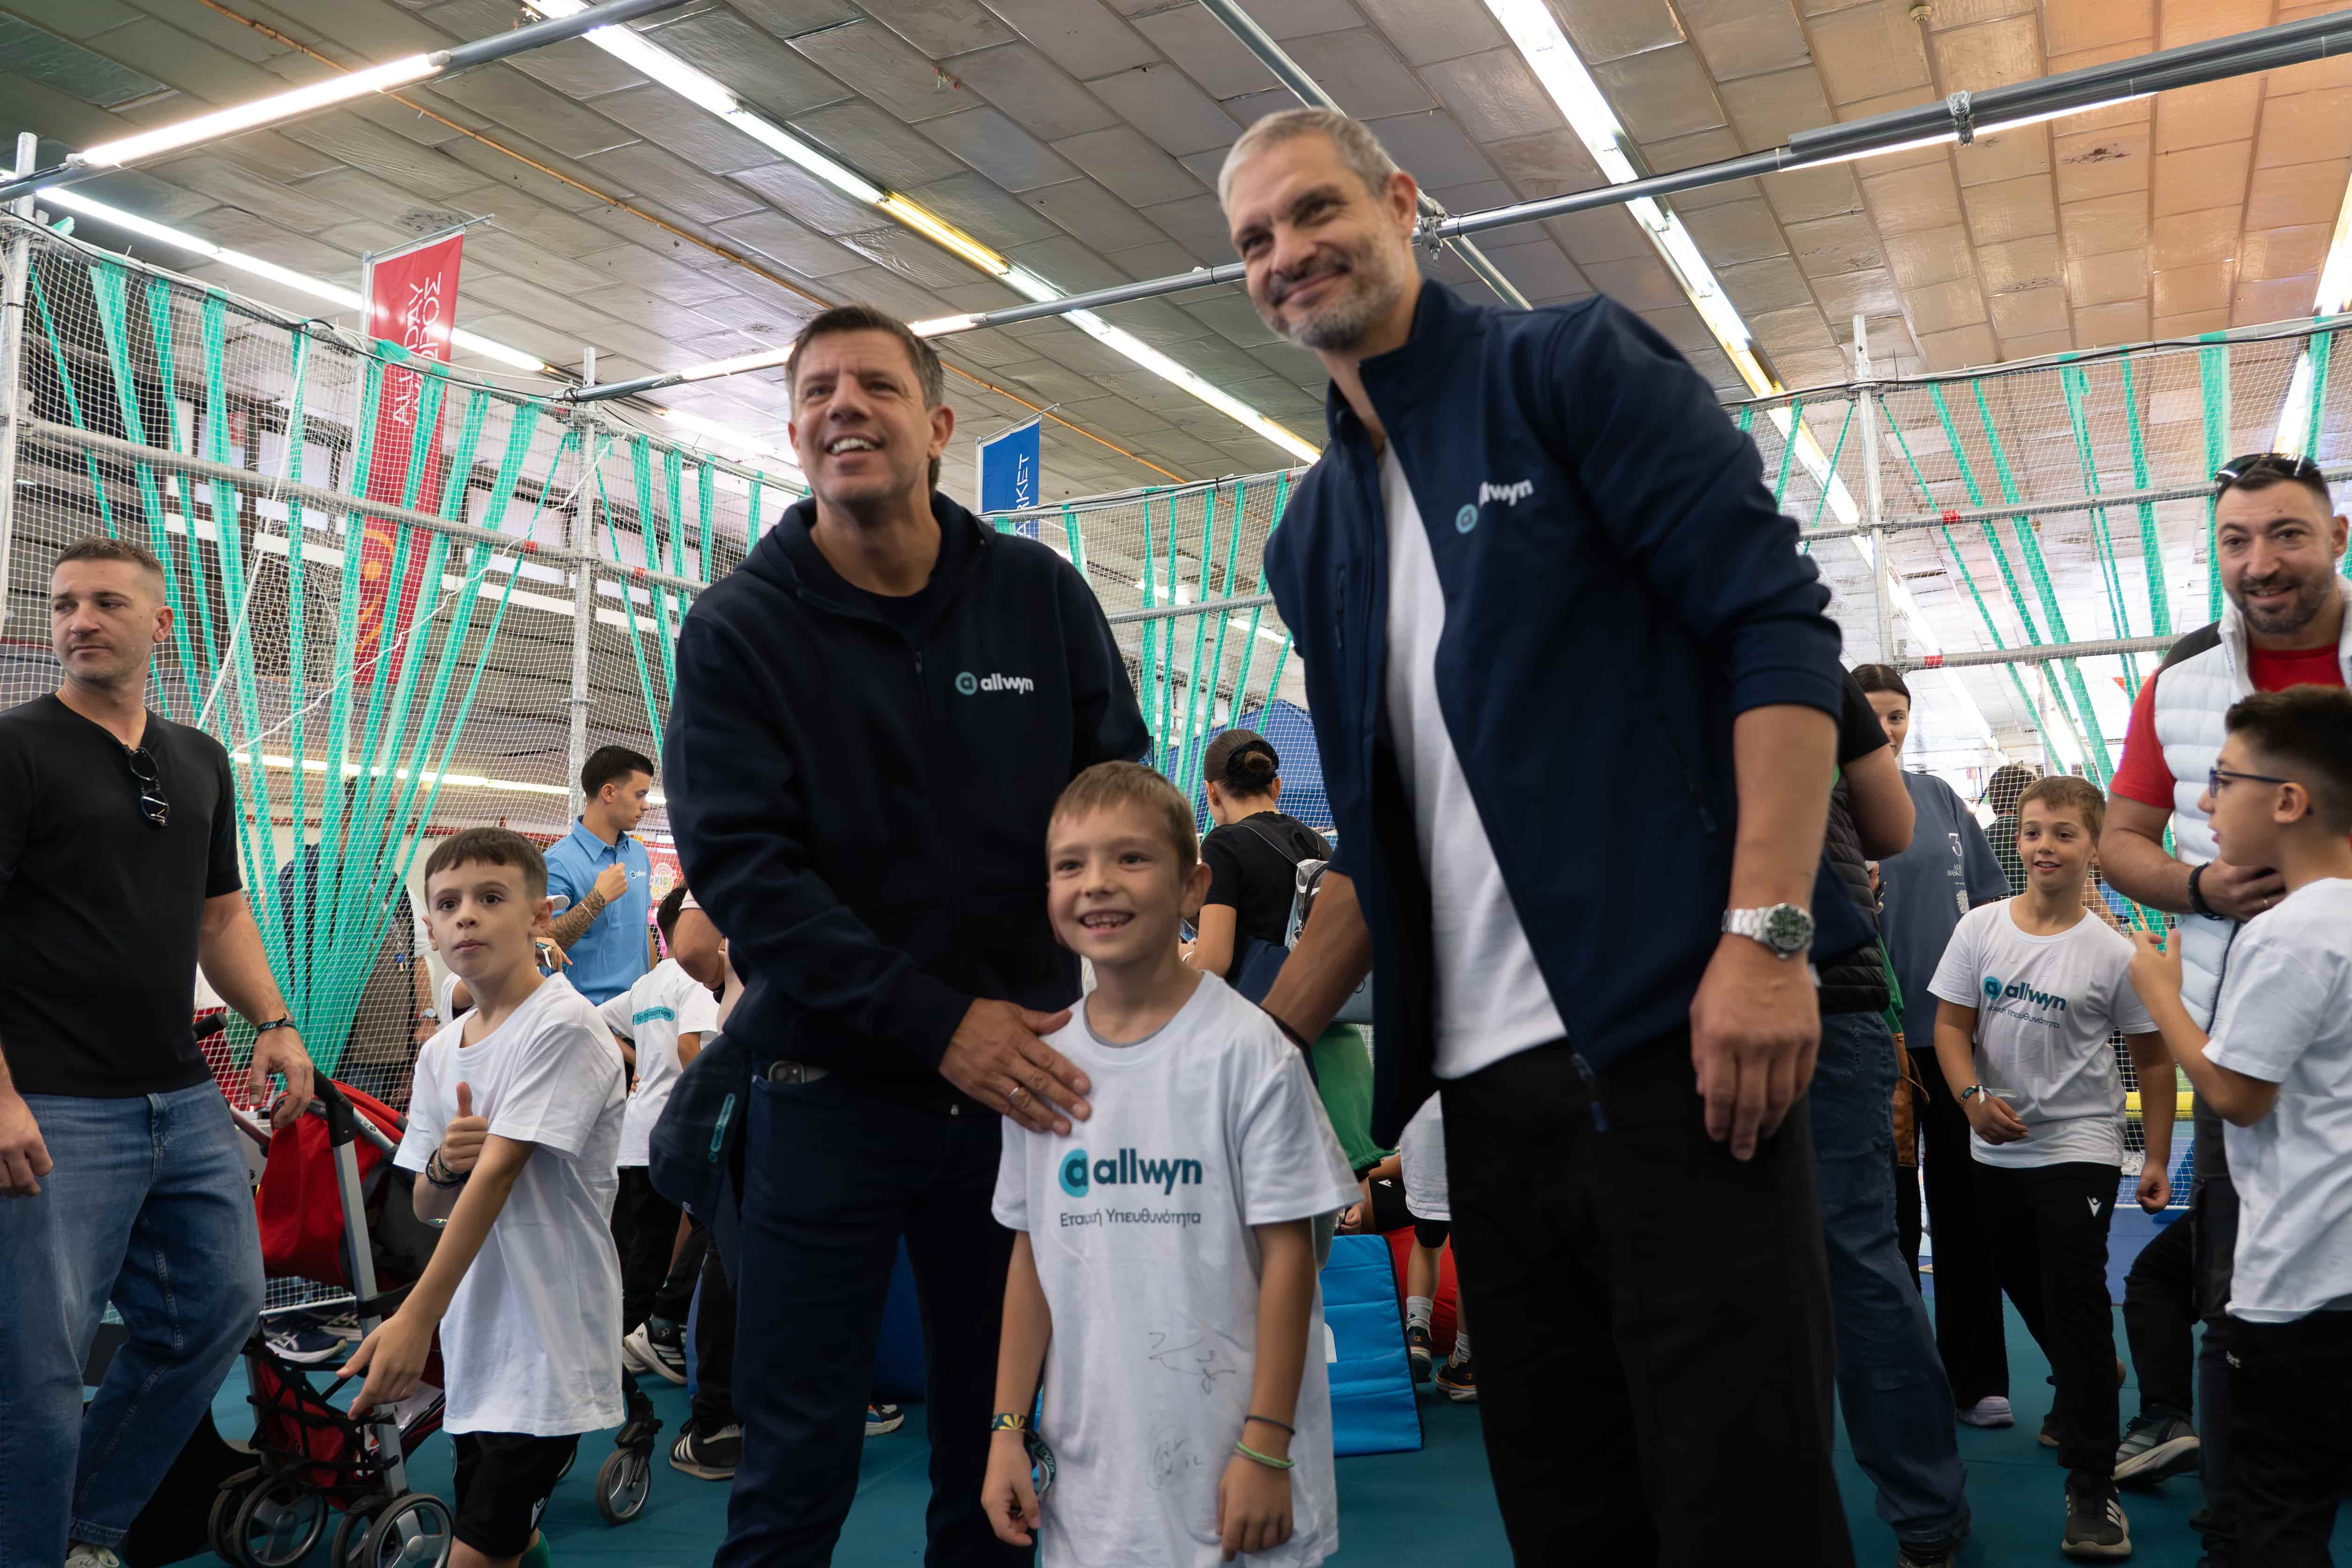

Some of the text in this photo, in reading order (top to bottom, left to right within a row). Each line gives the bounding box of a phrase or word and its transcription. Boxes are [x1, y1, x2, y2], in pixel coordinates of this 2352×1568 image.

[404, 283, 423, 351] DAY
[980, 673, 1034, 695] allwyn
[2005, 982, 2067, 1011] allwyn
[1093, 1148, 1203, 1195] allwyn
